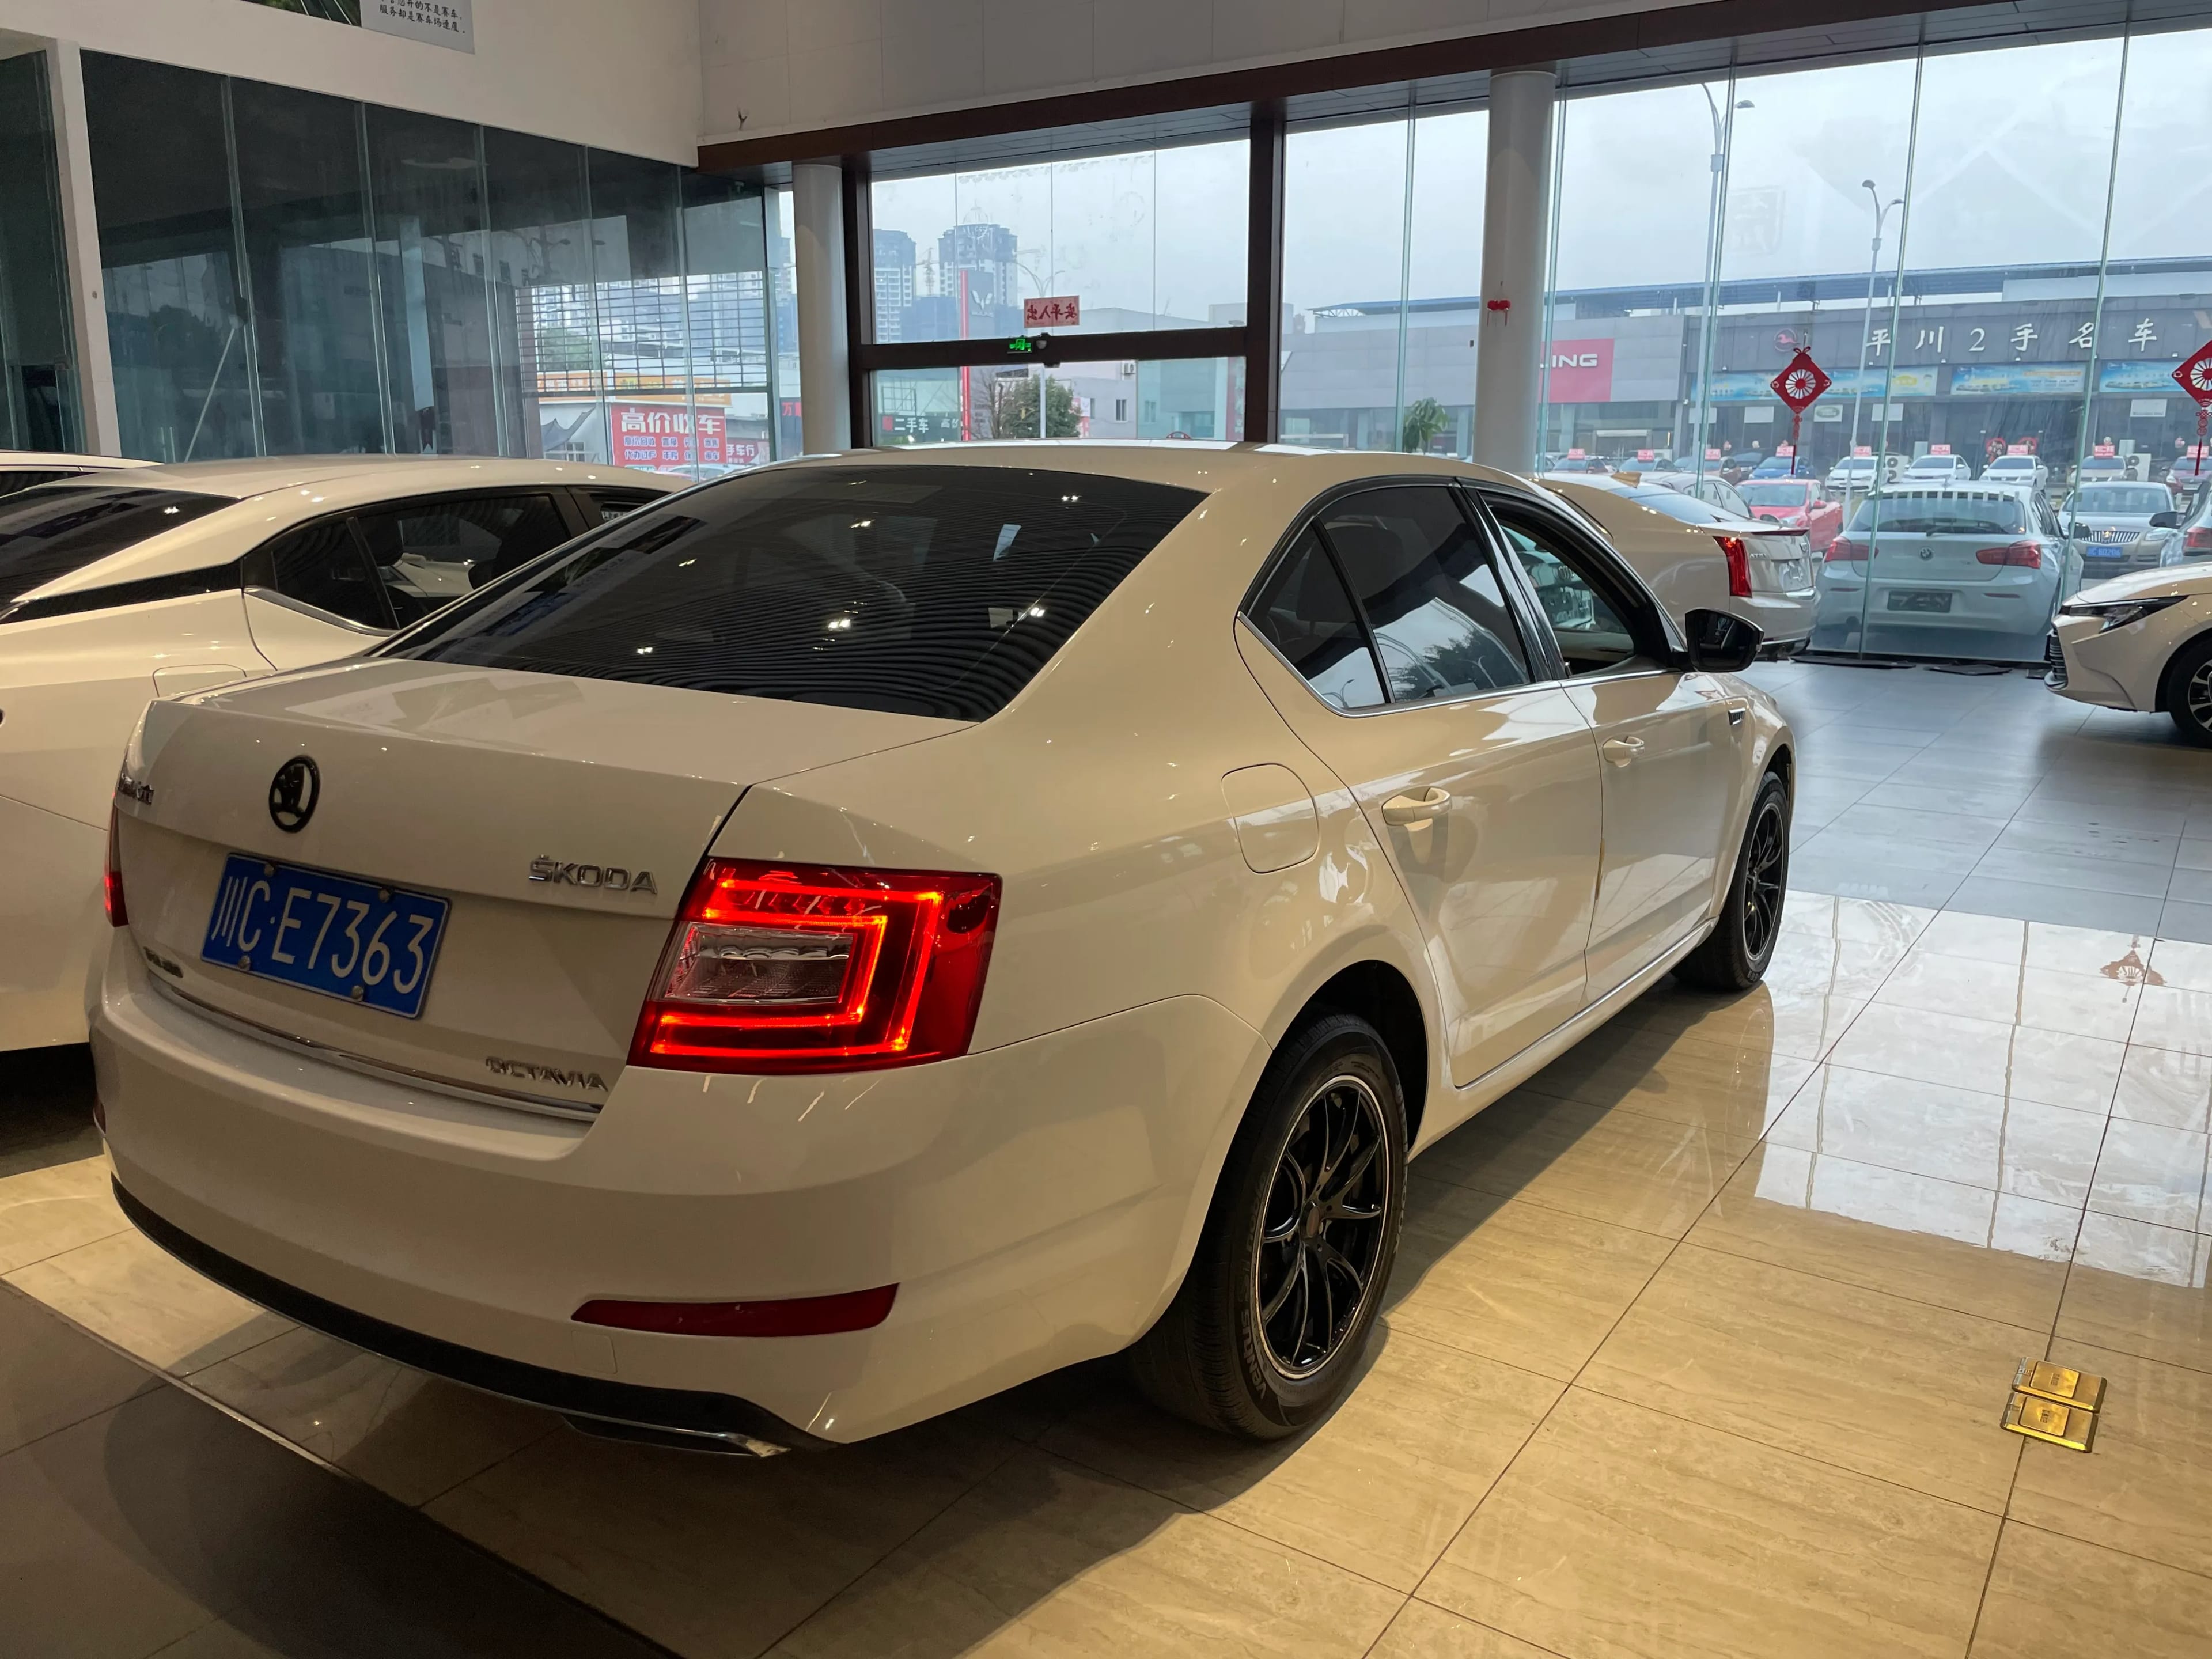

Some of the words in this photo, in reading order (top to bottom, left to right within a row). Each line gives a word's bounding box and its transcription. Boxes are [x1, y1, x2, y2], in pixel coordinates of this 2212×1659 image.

[621, 407, 724, 434] 高价收车
[894, 417, 929, 433] 二手车
[211, 876, 434, 993] 川C·E7363
